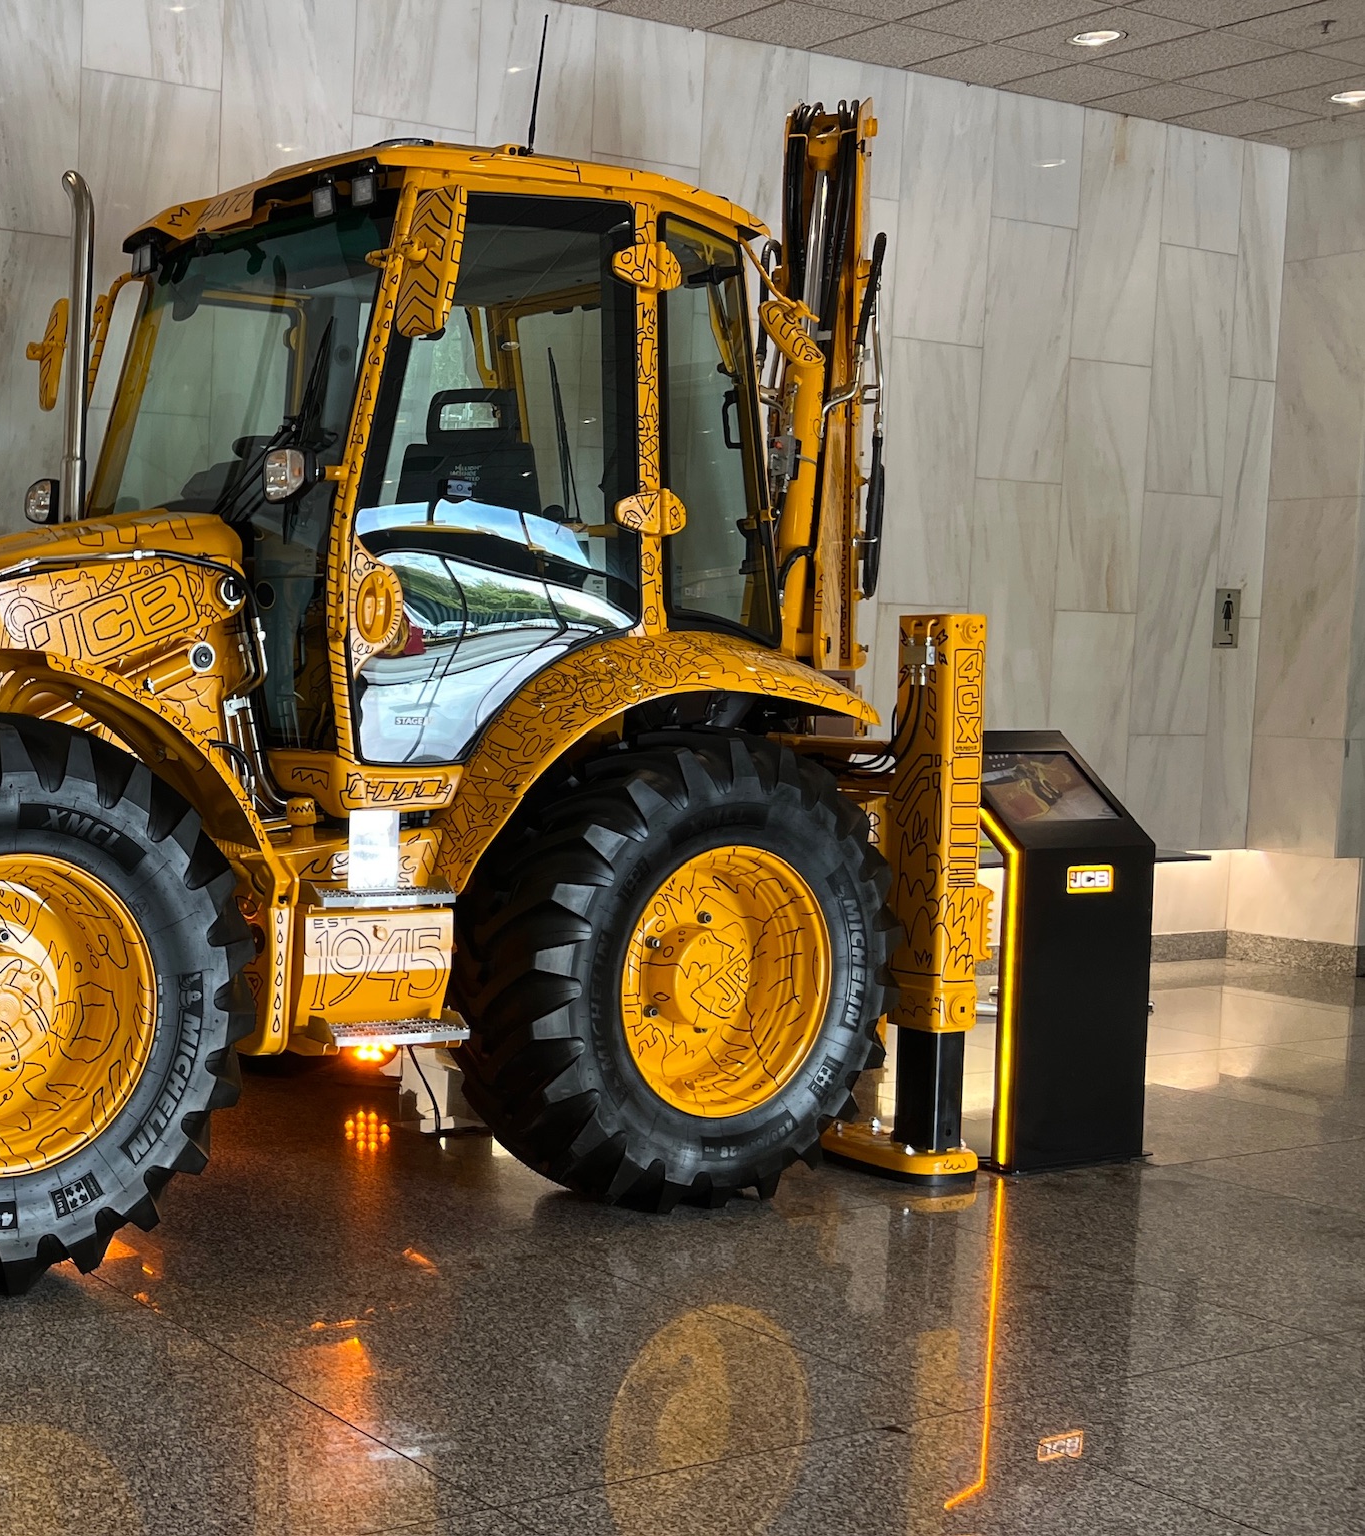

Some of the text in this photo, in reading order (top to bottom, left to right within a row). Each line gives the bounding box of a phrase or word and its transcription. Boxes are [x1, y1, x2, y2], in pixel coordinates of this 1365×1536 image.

[28, 573, 186, 661] JCB
[395, 716, 424, 726] STAGE
[957, 652, 982, 744] 4CX
[41, 807, 121, 851] XMCL
[1069, 870, 1110, 889] JCB
[313, 917, 355, 928] EST
[309, 927, 446, 1011] 1945
[842, 901, 867, 1029] MICHELIN
[127, 1014, 202, 1165] MICHELIN
